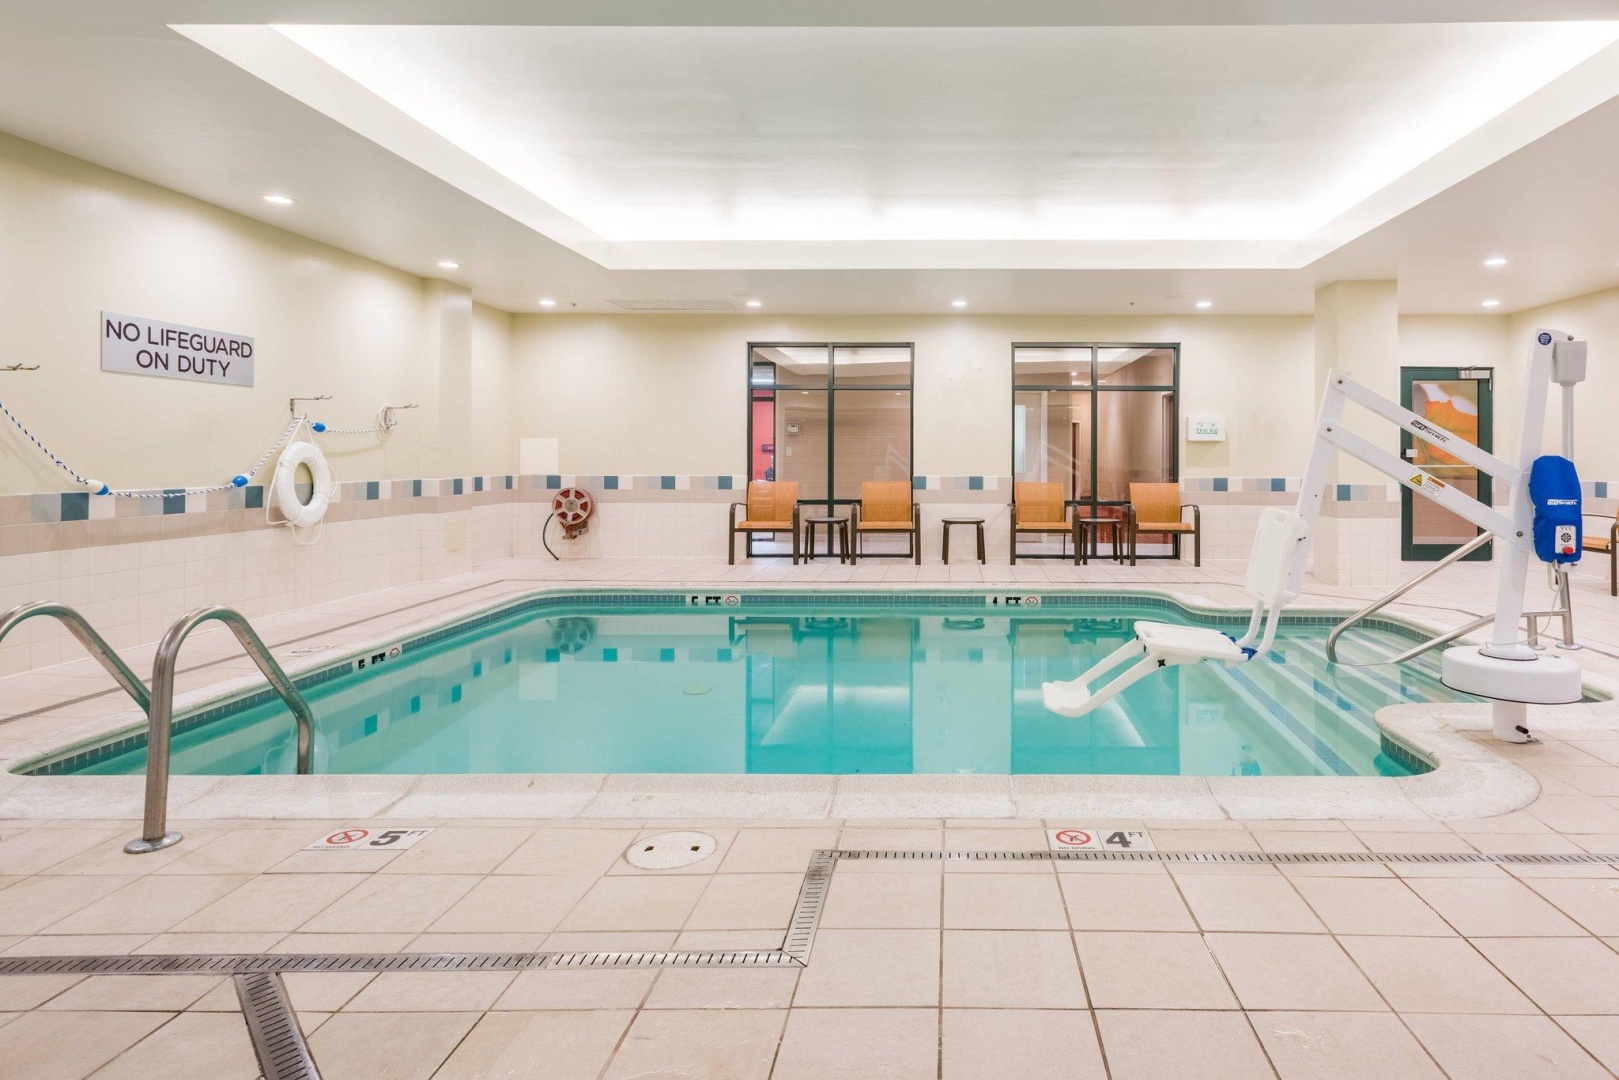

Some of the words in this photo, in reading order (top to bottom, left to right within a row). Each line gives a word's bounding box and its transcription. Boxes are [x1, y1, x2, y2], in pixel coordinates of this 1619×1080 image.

[106, 319, 140, 342] NO
[148, 326, 252, 358] LIFEGUARD
[136, 349, 168, 371] ON
[178, 355, 230, 377] DUTY
[358, 658, 365, 669] 5
[371, 652, 386, 665] FT
[369, 830, 409, 846] 5
[1105, 831, 1132, 848] 4
